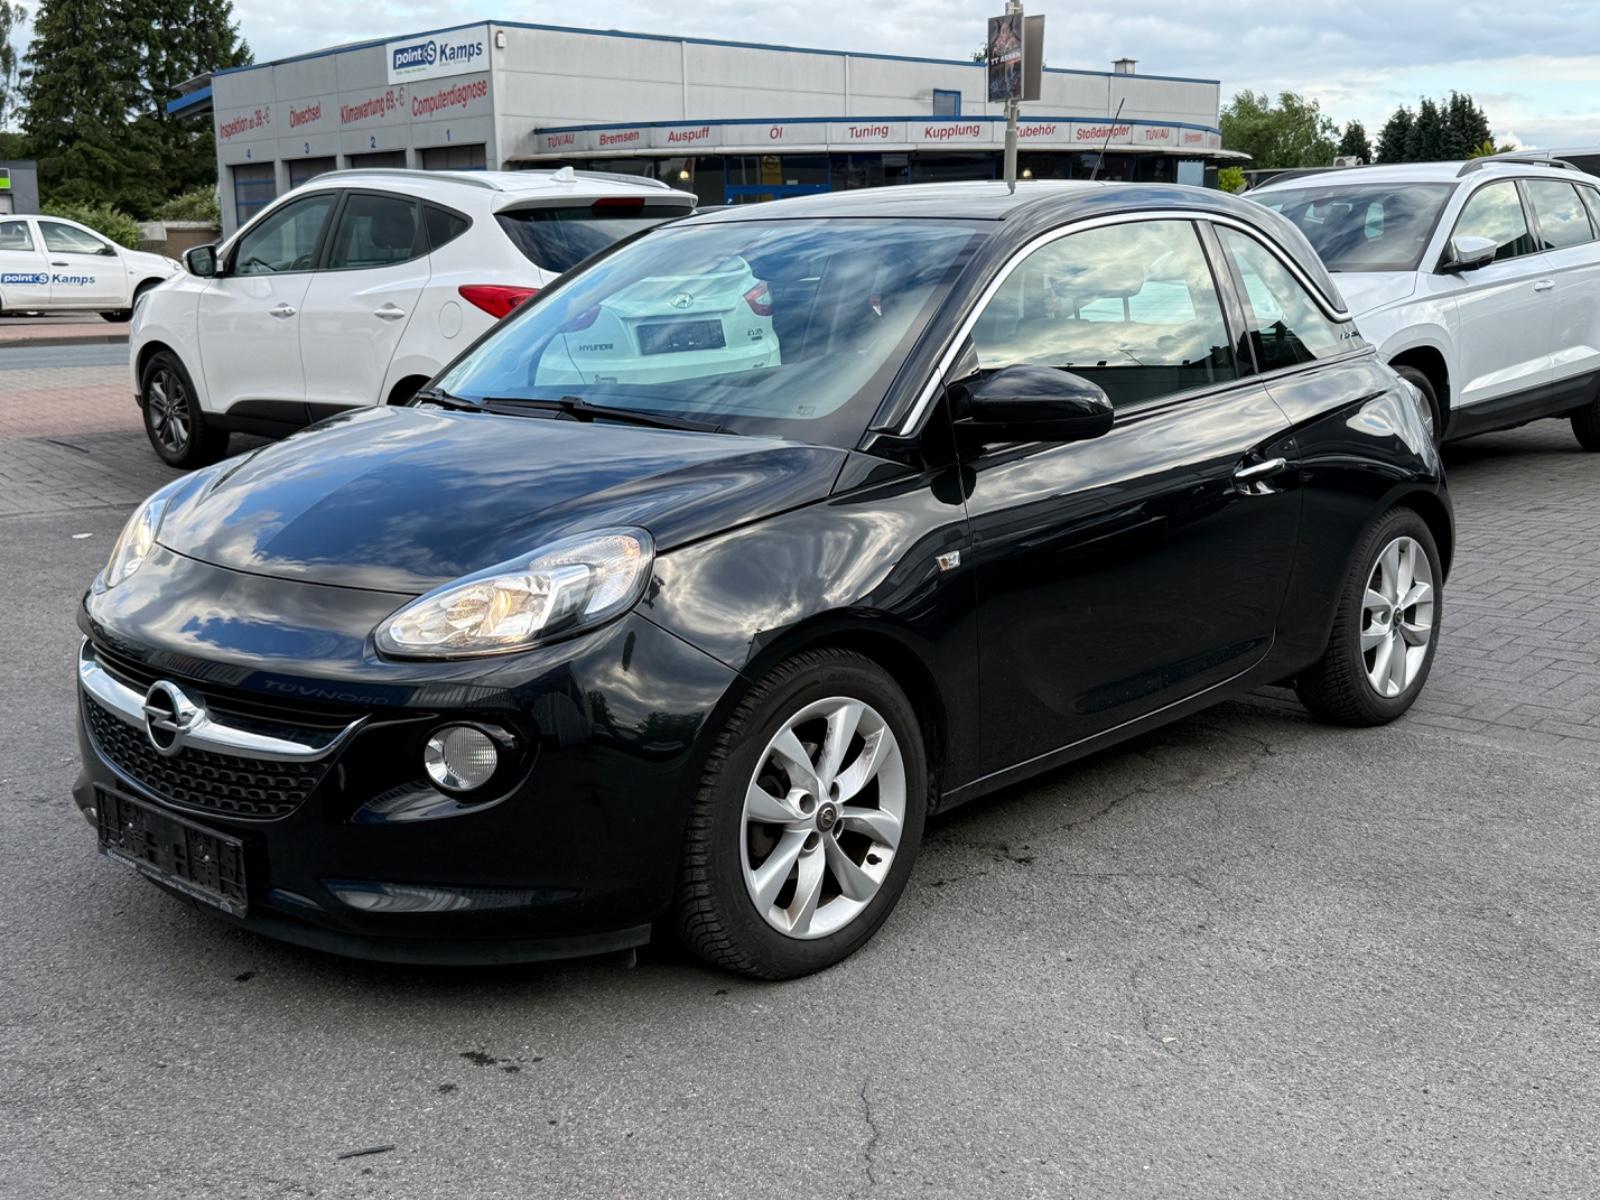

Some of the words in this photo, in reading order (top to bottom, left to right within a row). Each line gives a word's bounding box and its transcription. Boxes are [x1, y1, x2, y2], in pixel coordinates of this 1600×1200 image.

[395, 47, 422, 68] point
[439, 42, 483, 63] Kamps
[411, 80, 488, 117] Computerdiagnose
[289, 101, 321, 129] Ölwechsel
[340, 95, 386, 125] Klimawartung
[220, 115, 248, 140] Inspektion
[446, 129, 451, 141] 1
[667, 126, 710, 144] Auspuff
[769, 126, 783, 140] Öl
[848, 124, 889, 139] Tuning
[924, 123, 981, 140] Kupplung
[1076, 125, 1130, 141] Stoßdämpfer
[370, 136, 376, 148] 2
[599, 131, 640, 146] Bremsen
[304, 142, 310, 154] 3
[4, 273, 33, 285] point
[52, 274, 96, 286] Kamps
[578, 343, 614, 352] HYUNDAI
